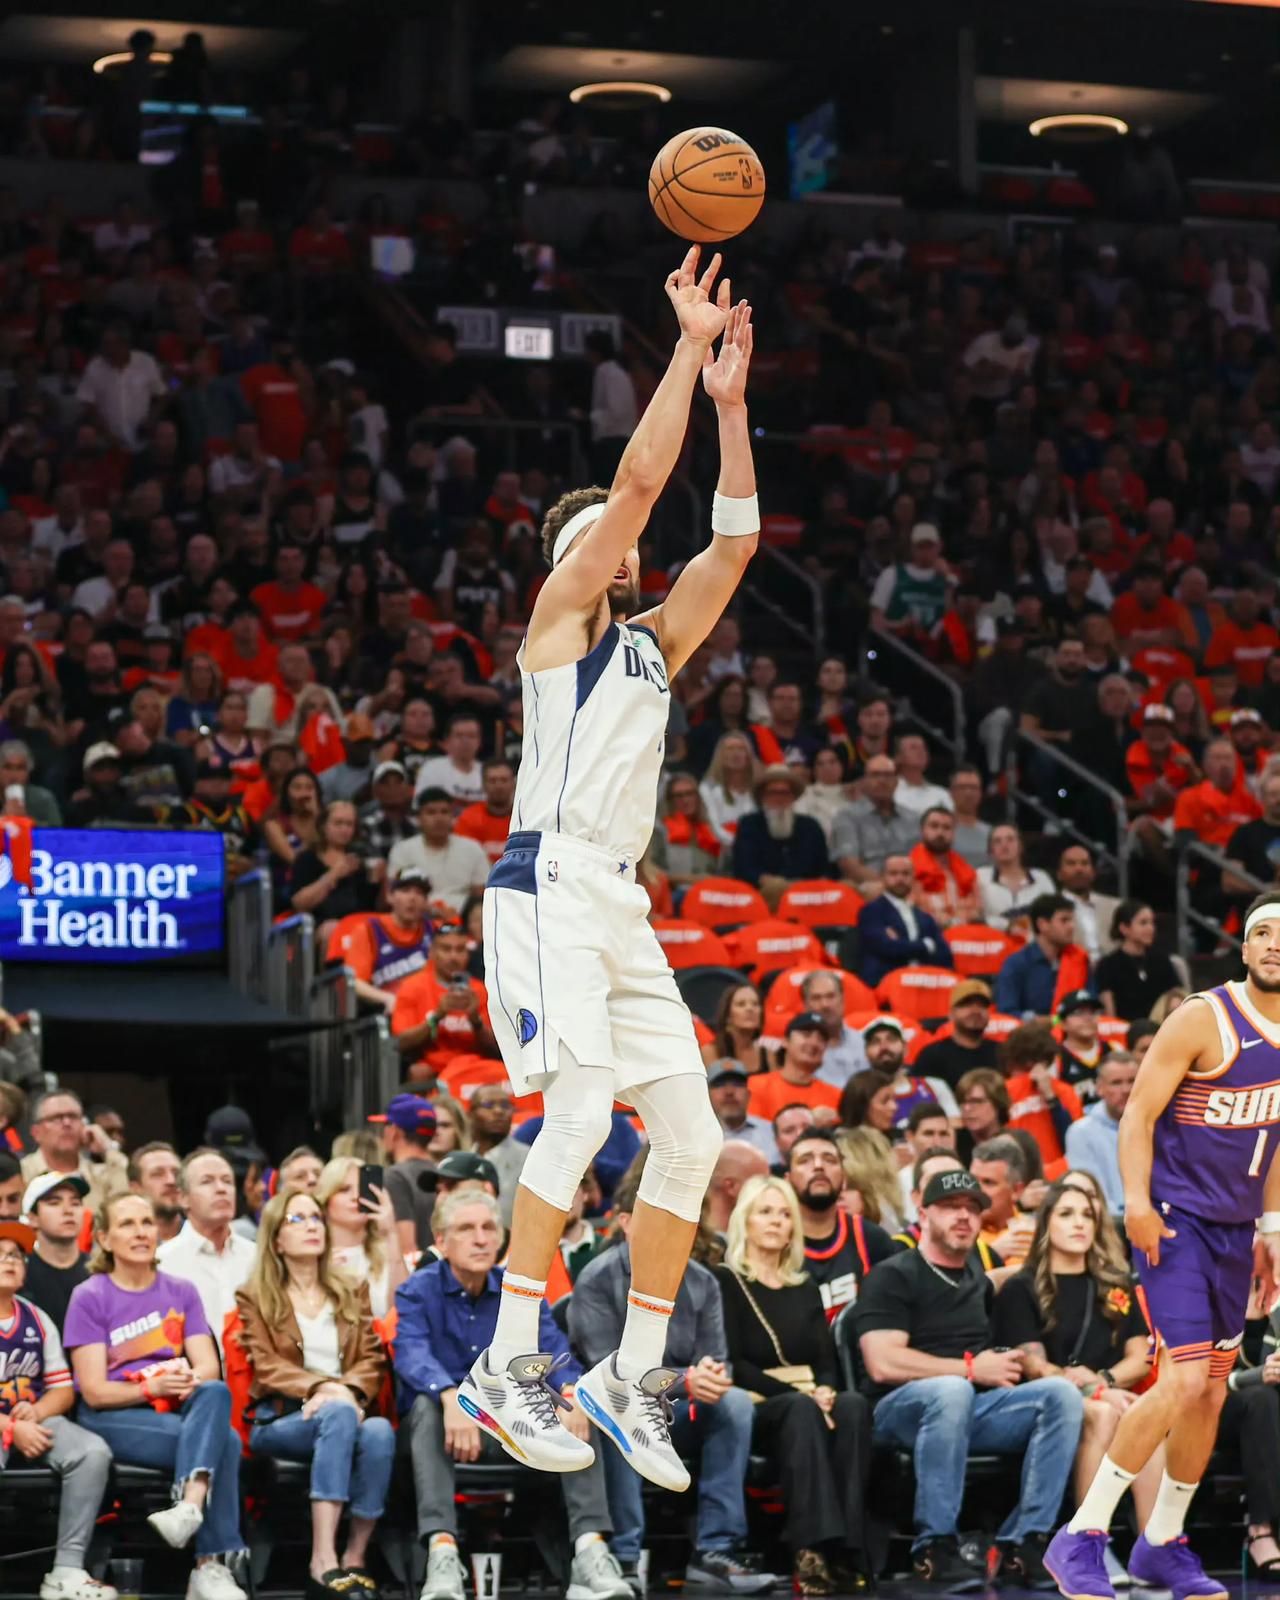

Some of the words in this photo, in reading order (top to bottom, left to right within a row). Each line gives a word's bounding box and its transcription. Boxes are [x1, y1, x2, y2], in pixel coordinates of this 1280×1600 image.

[18, 849, 198, 899] Banner
[17, 898, 178, 948] Health
[1248, 1129, 1268, 1177] 1
[109, 1311, 162, 1347] SUNS
